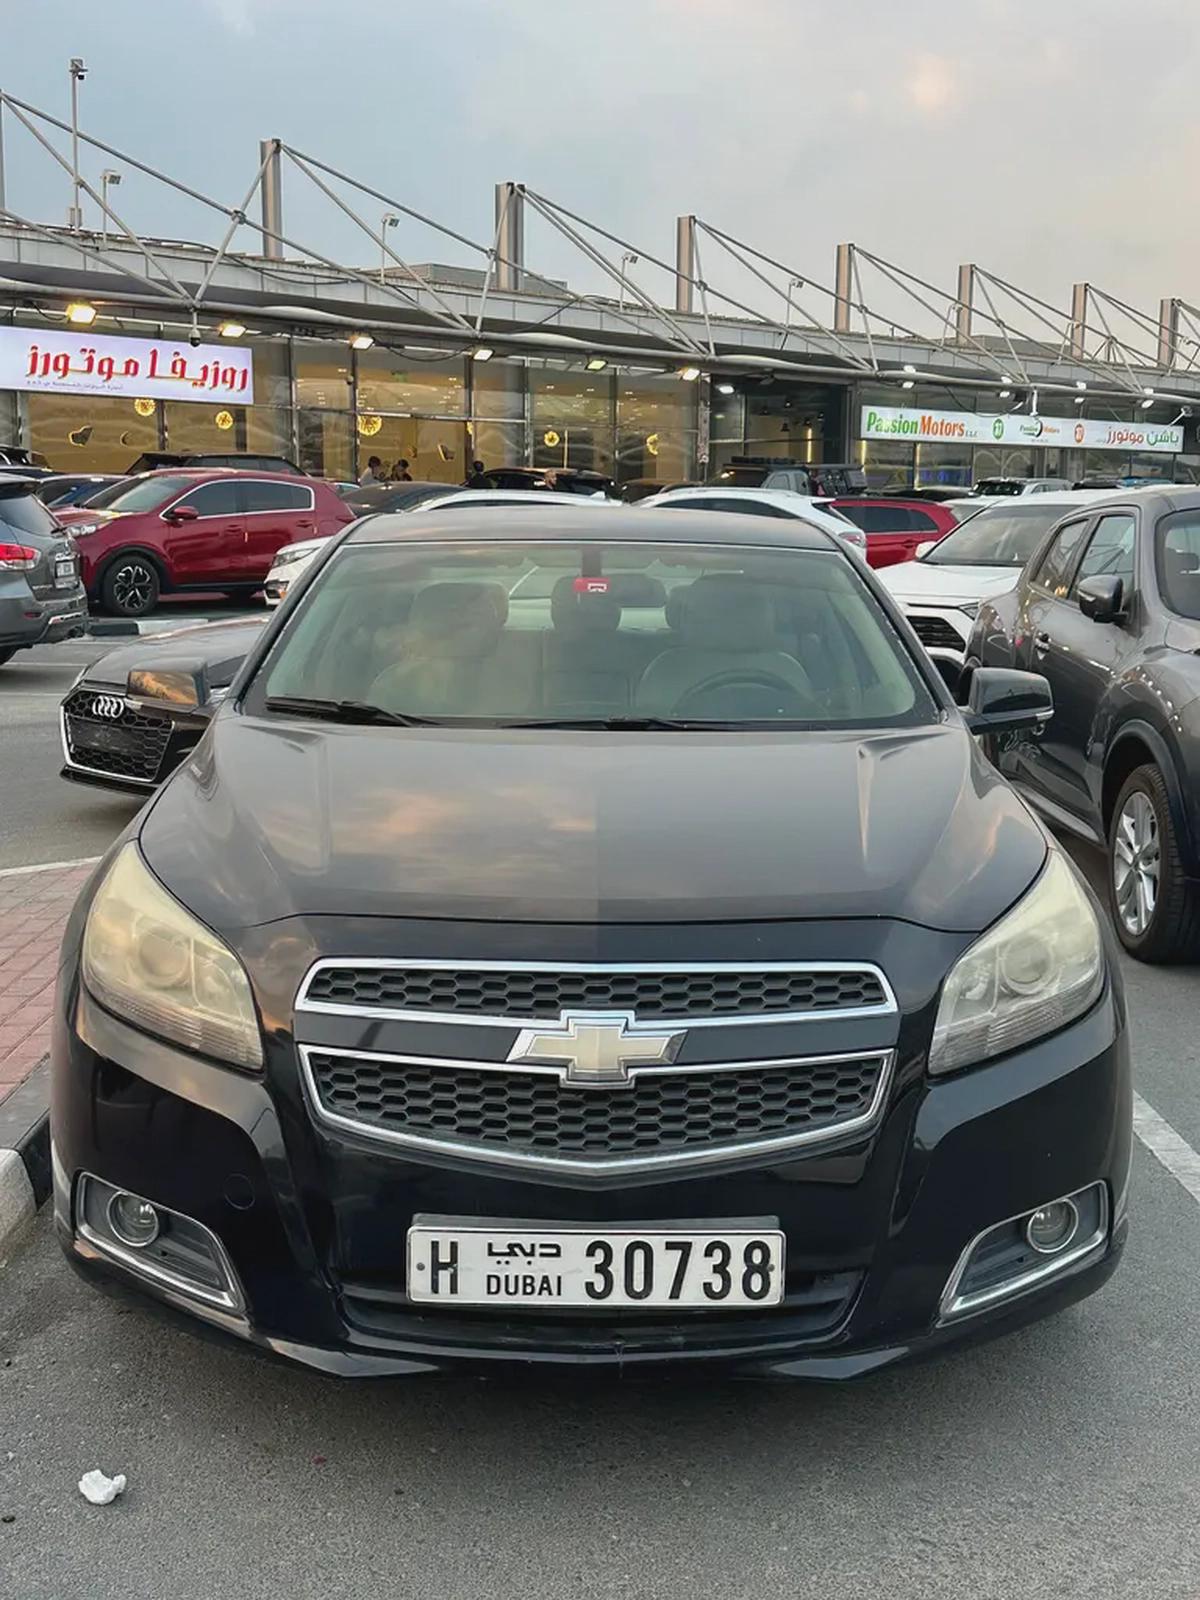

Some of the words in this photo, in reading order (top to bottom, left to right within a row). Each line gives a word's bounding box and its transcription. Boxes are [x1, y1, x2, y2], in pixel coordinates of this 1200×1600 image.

[25, 345, 140, 382] موتورز
[146, 348, 249, 391] روزيفا
[919, 415, 965, 437] Motors
[1106, 426, 1144, 446] موتورز
[1146, 429, 1180, 447] باشن
[487, 1242, 562, 1266] دبي
[430, 1240, 459, 1295] H
[584, 1240, 772, 1301] 30738
[486, 1275, 562, 1297] DUBAI
